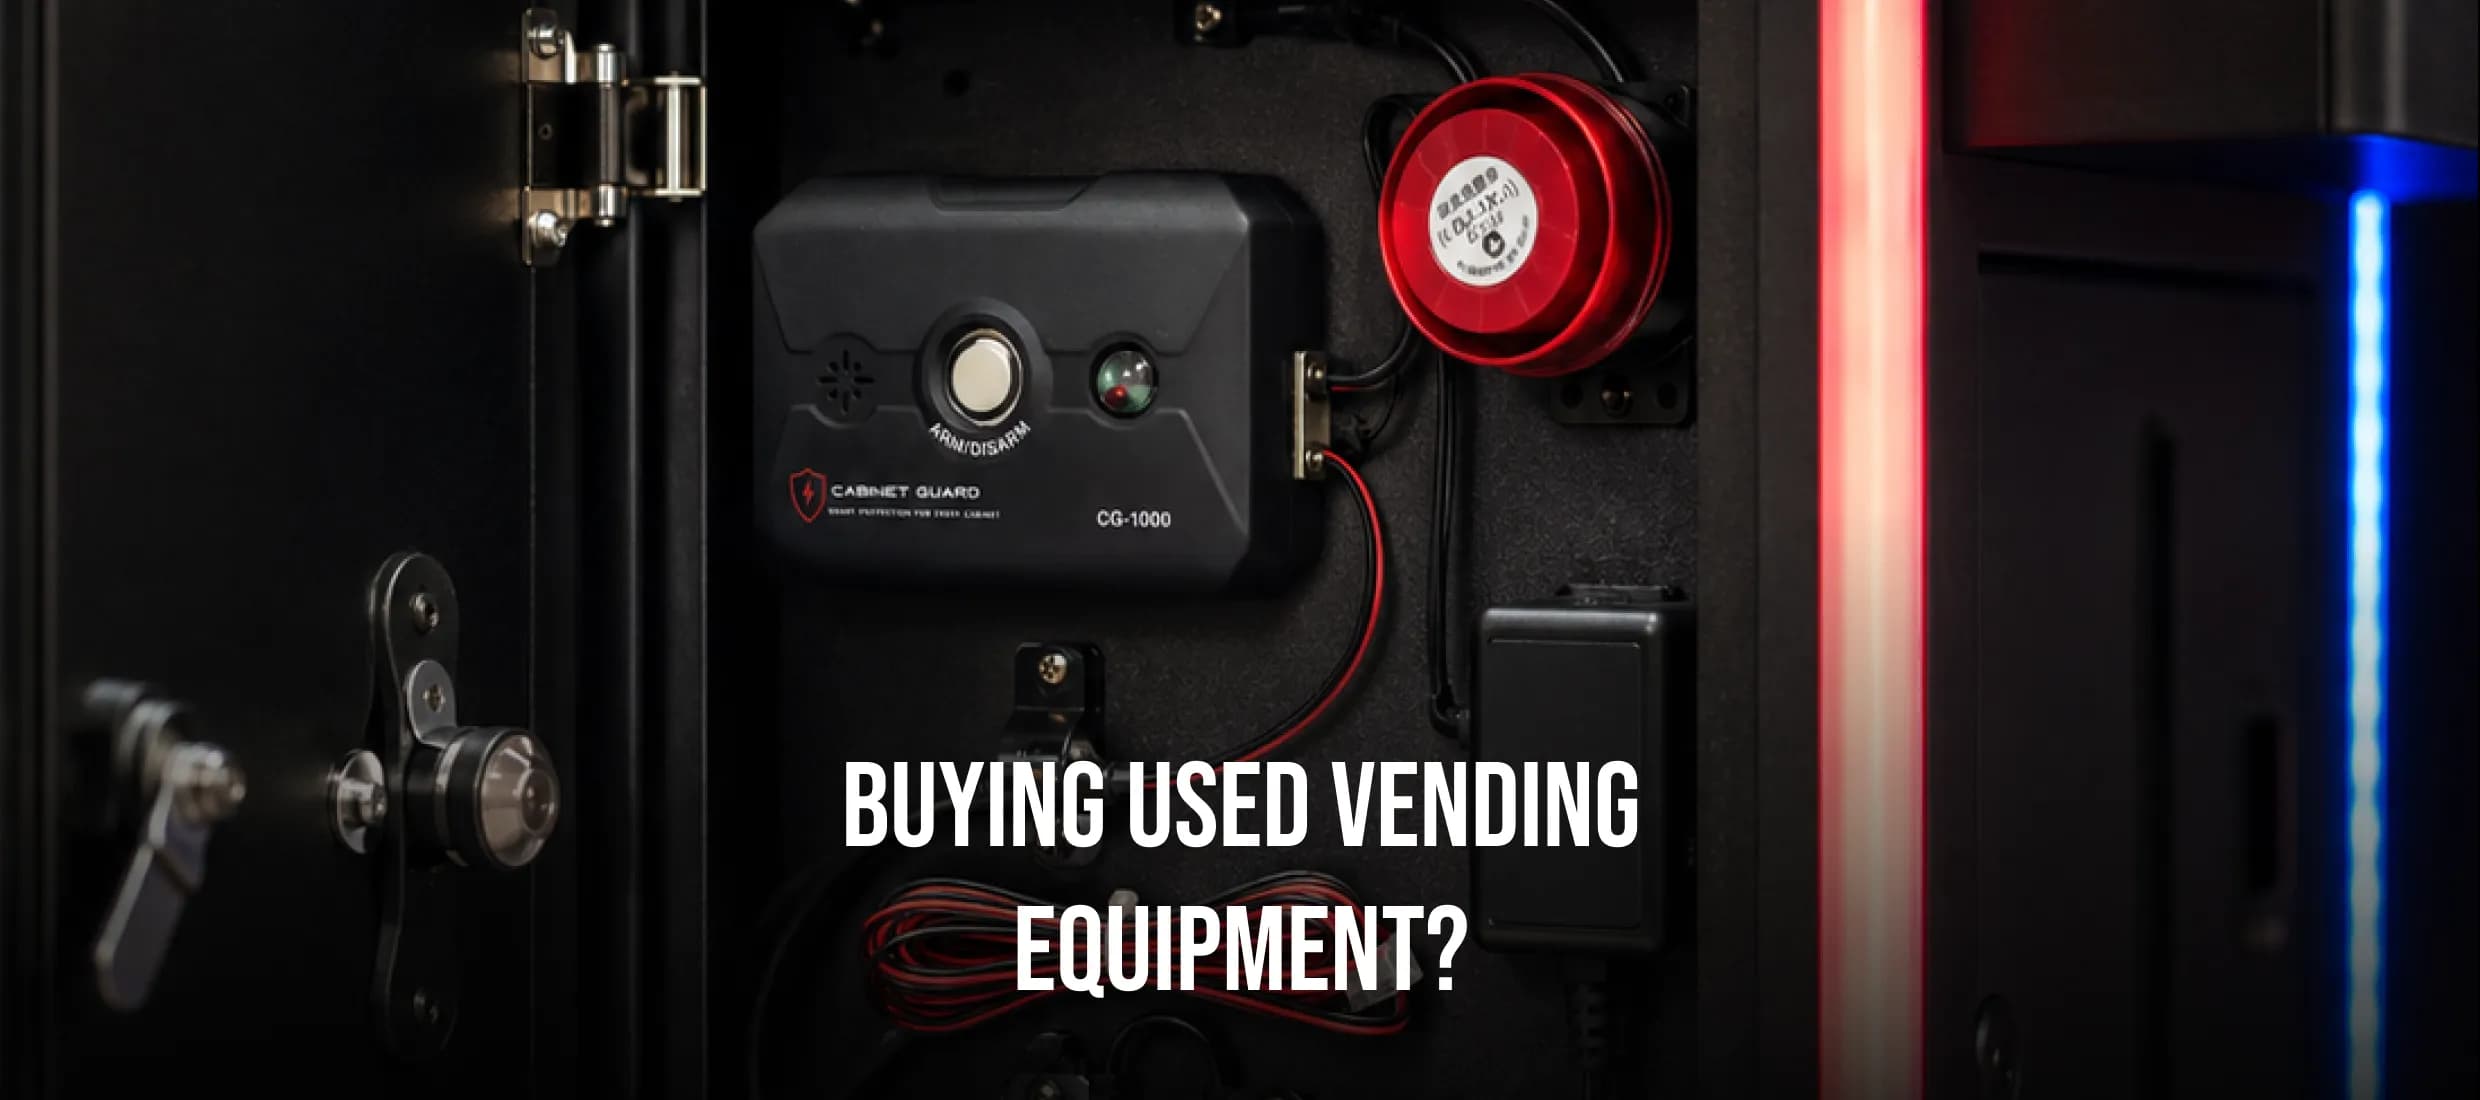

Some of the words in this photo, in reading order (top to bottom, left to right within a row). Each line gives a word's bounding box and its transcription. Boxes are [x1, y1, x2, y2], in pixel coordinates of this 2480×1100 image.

[927, 419, 1032, 456] ARM/DISARM
[830, 484, 910, 499] CABINET
[915, 484, 981, 500] GUARD
[1095, 508, 1172, 529] CG-1000
